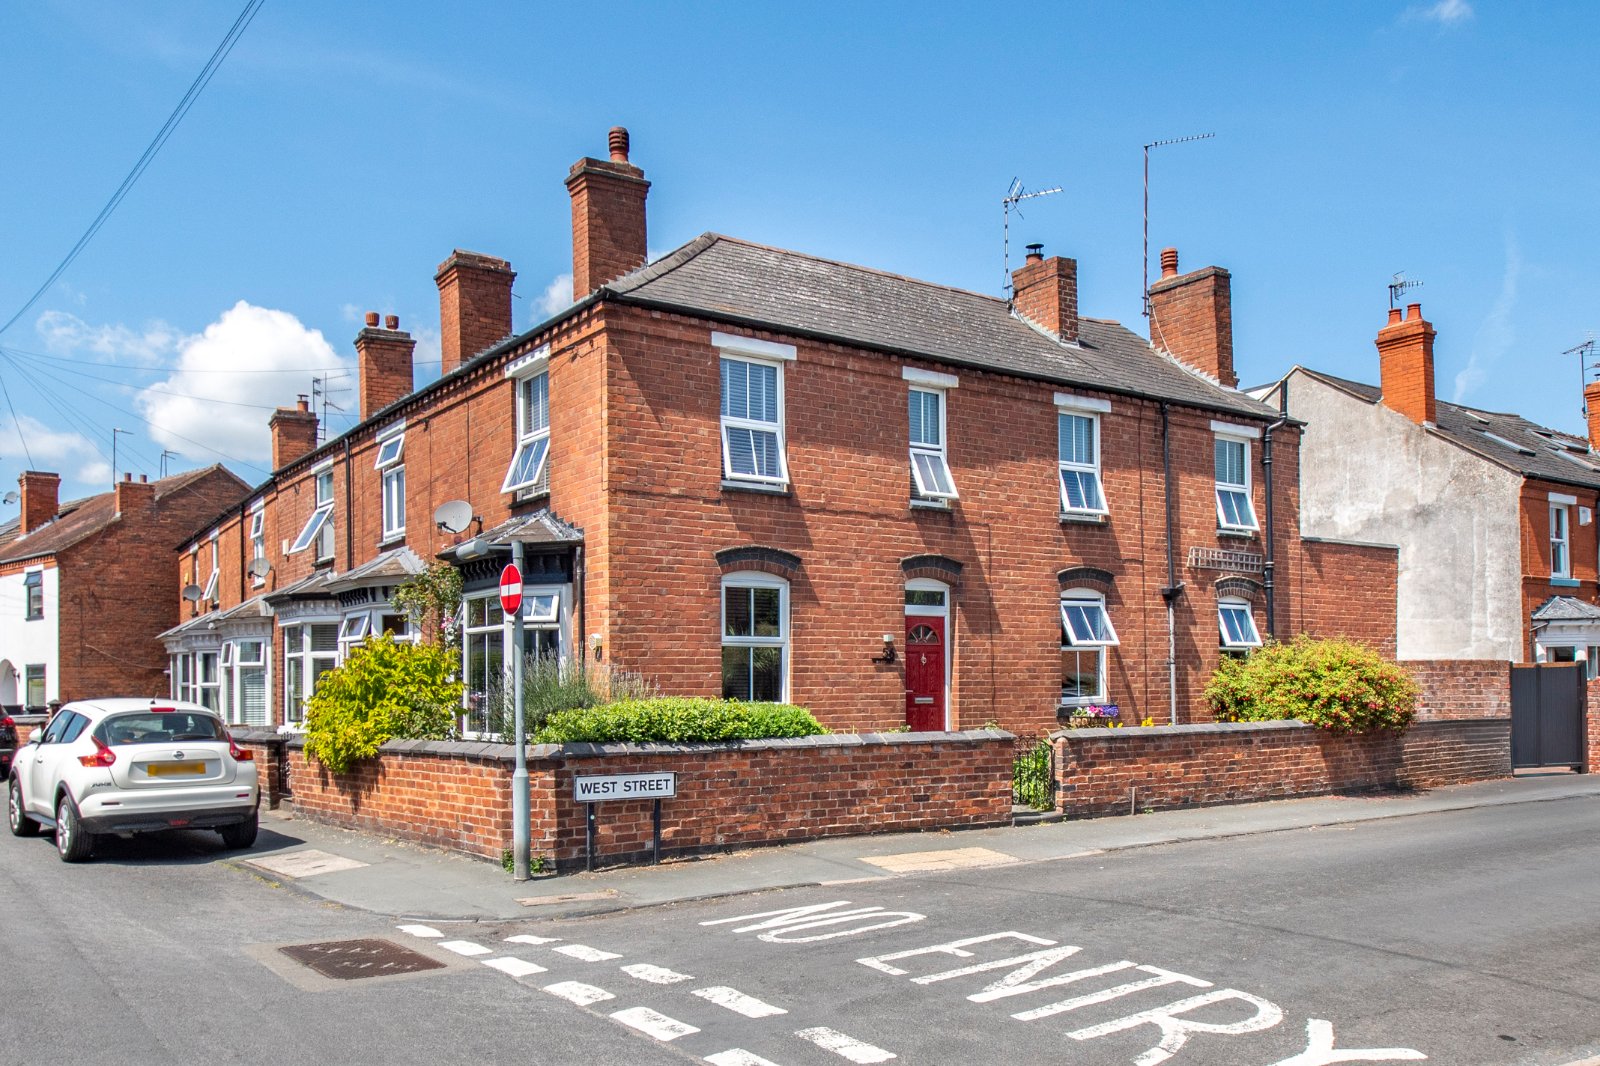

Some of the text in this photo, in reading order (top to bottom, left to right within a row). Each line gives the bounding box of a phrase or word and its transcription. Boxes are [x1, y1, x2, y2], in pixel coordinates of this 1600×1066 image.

[580, 779, 670, 794] WEST STREET
[698, 900, 927, 943] NO
[856, 930, 1428, 1066] ENTRY
